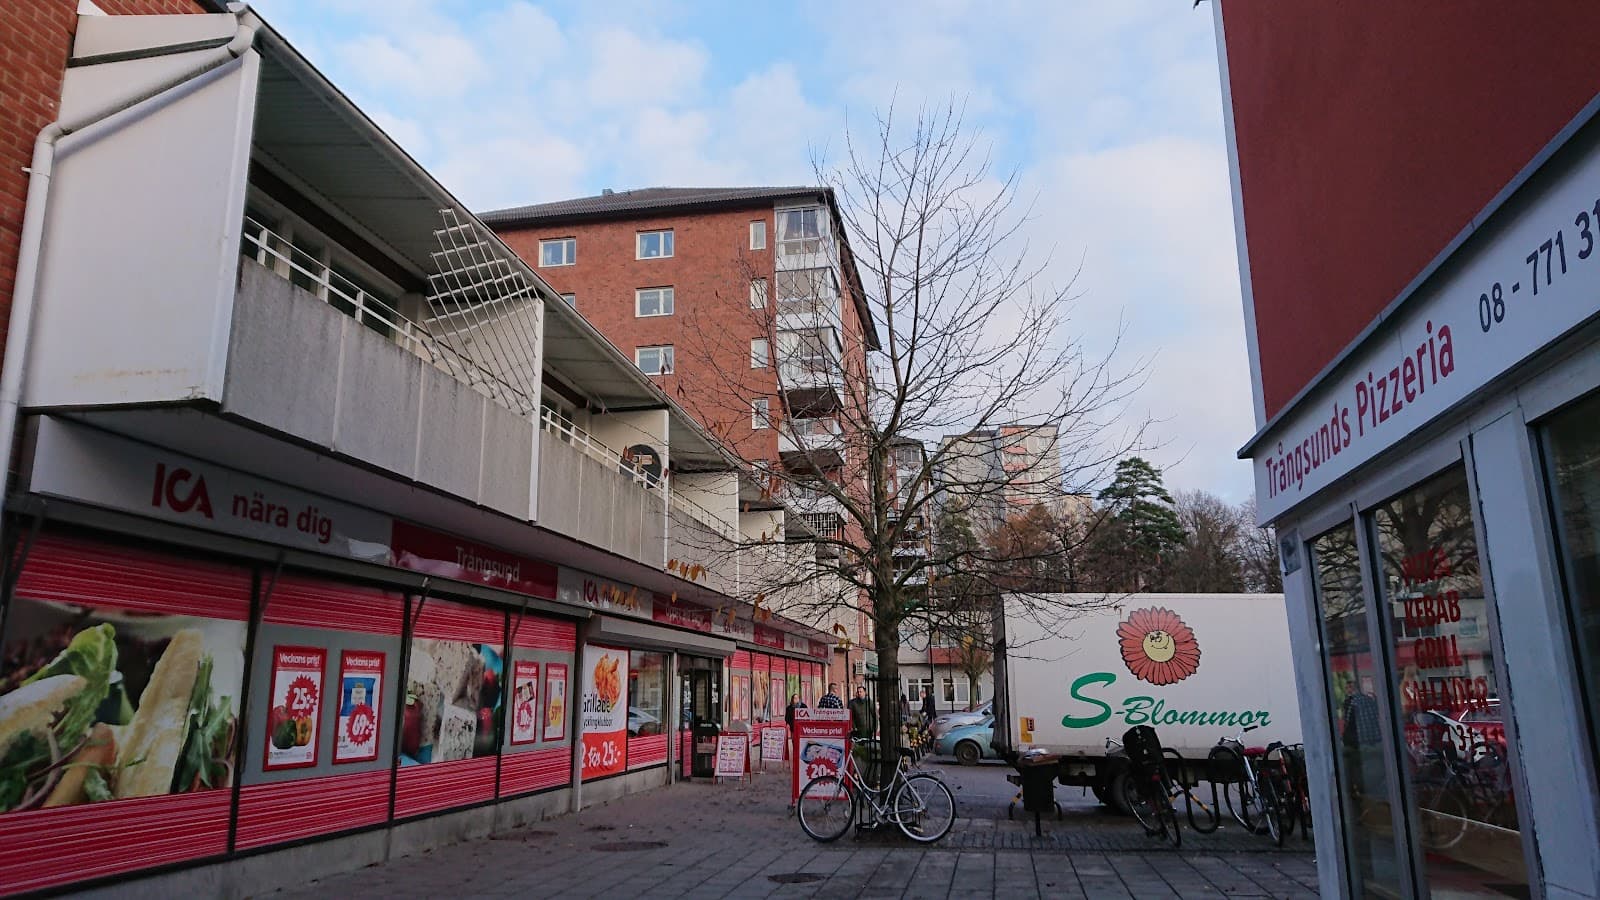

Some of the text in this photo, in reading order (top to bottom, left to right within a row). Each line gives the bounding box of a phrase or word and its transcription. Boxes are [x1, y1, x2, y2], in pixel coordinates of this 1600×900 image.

[1265, 402, 1352, 499] Trångsunds
[1355, 320, 1455, 437] Pizzeria
[1479, 282, 1505, 333] 08
[1526, 229, 1567, 296] 771
[151, 463, 333, 544] ICA nära dig
[455, 545, 521, 584] Trångsund
[583, 579, 599, 604] ICA
[1404, 589, 1461, 630] KEBAB
[279, 652, 306, 665] Veckans
[345, 656, 368, 667] Veckans
[1414, 634, 1463, 669] GRILL
[795, 710, 810, 718] ICA
[1061, 672, 1272, 729] S-Blommor
[802, 727, 829, 735] Veckans
